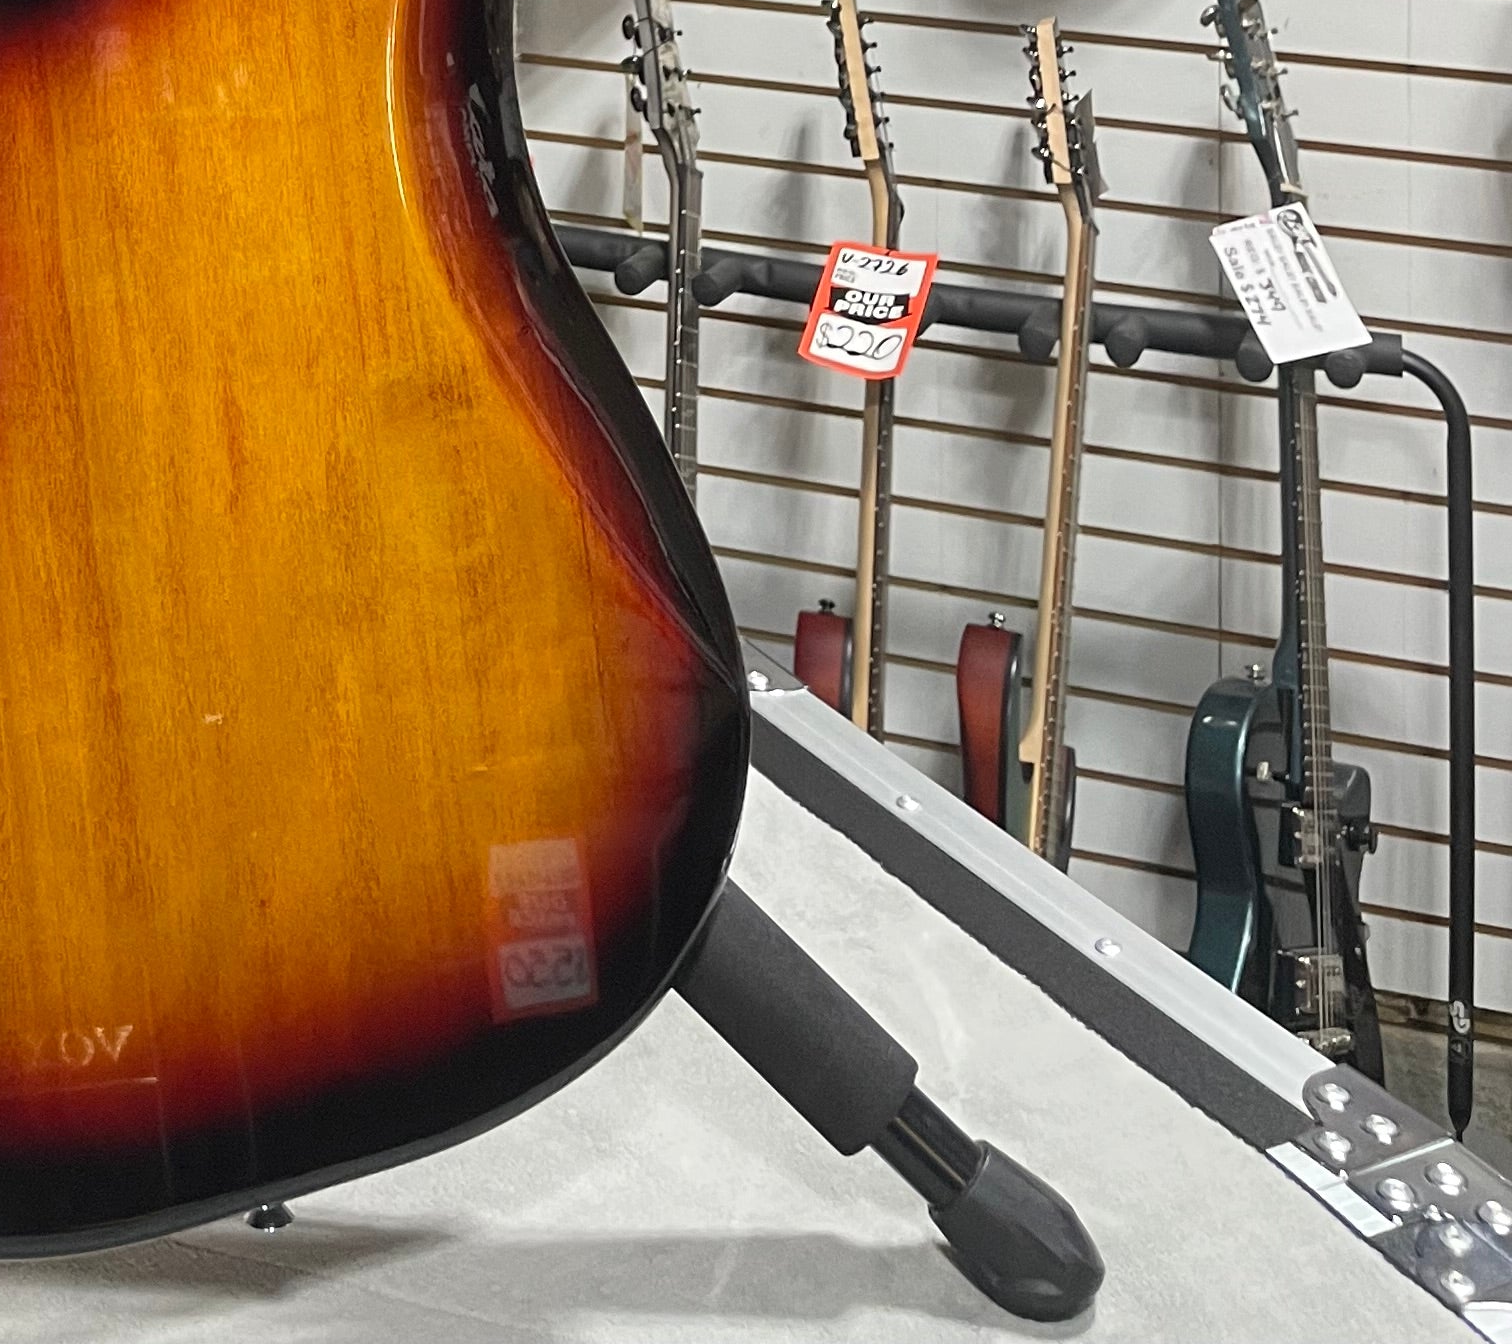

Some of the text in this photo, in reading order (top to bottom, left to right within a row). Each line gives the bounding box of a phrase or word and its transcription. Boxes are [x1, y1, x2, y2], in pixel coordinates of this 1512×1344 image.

[845, 290, 896, 307] OUR
[834, 299, 904, 319] PRICE
[816, 321, 903, 360] $220
